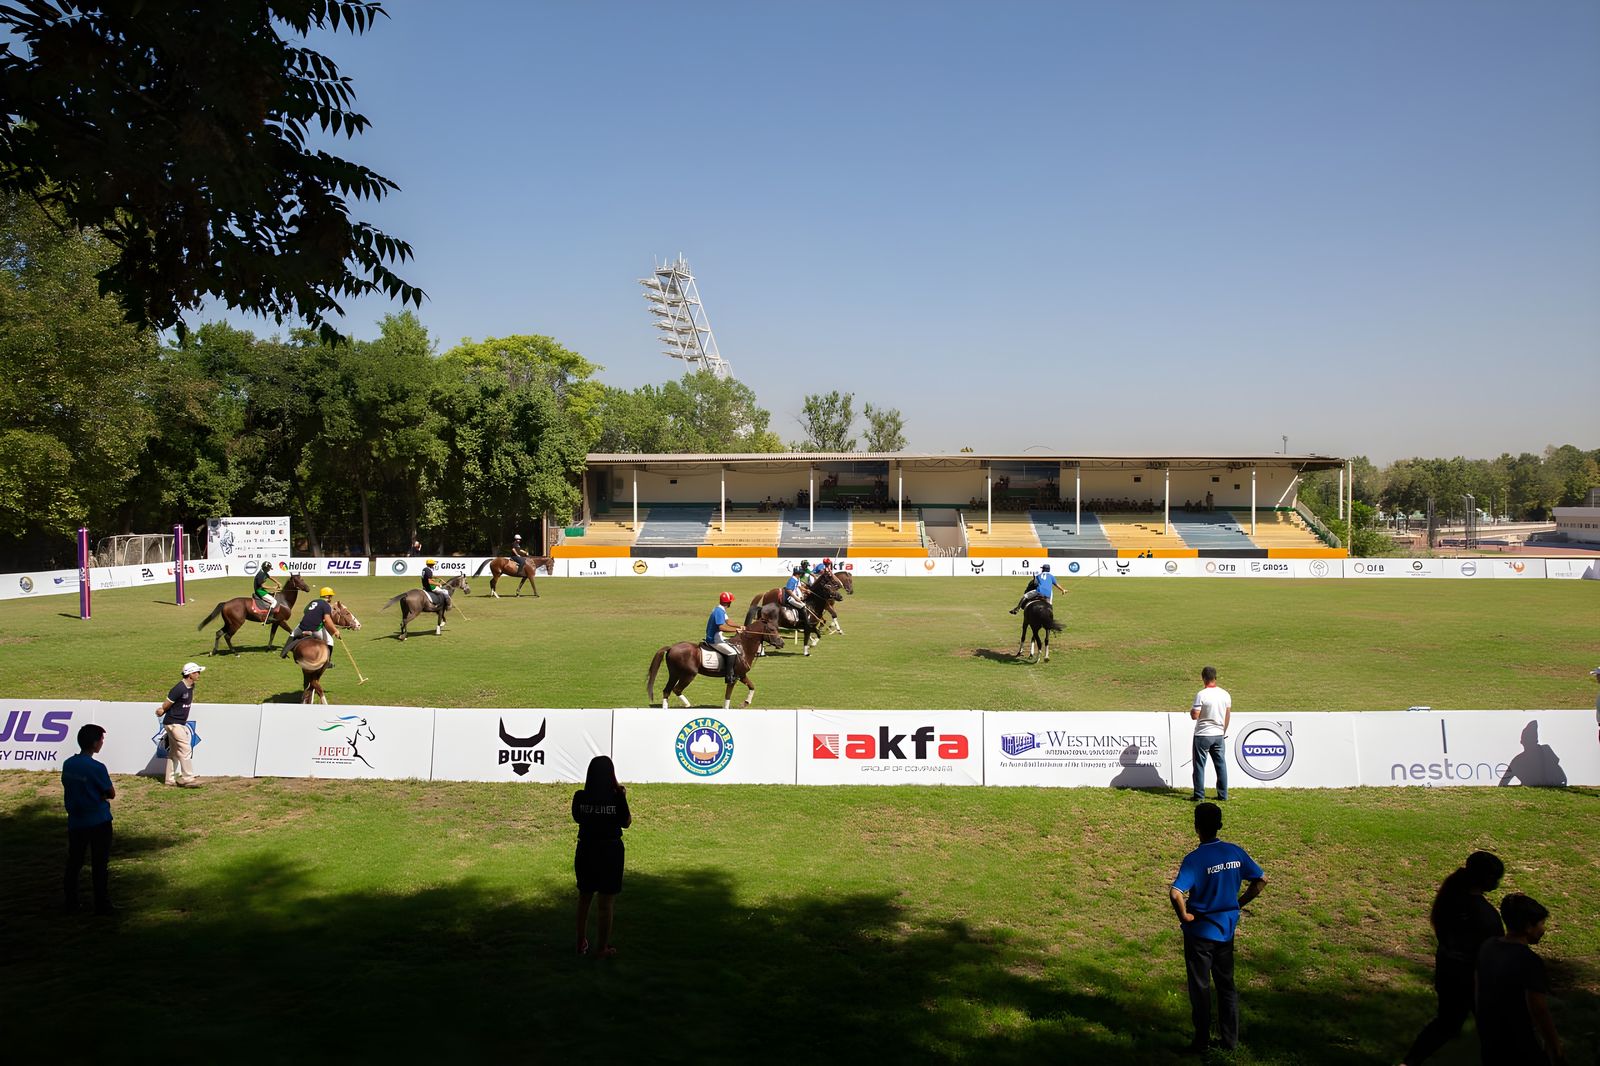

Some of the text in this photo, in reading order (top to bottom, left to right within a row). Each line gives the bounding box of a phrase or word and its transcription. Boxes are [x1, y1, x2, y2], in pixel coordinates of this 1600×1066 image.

[327, 561, 364, 570] PULS
[308, 601, 319, 610] 3
[845, 726, 969, 760] akfa
[1046, 731, 1158, 748] WESTMINSTER
[15, 751, 58, 761] DRINK
[498, 750, 545, 765] BUKA
[1391, 758, 1511, 780] nestone
